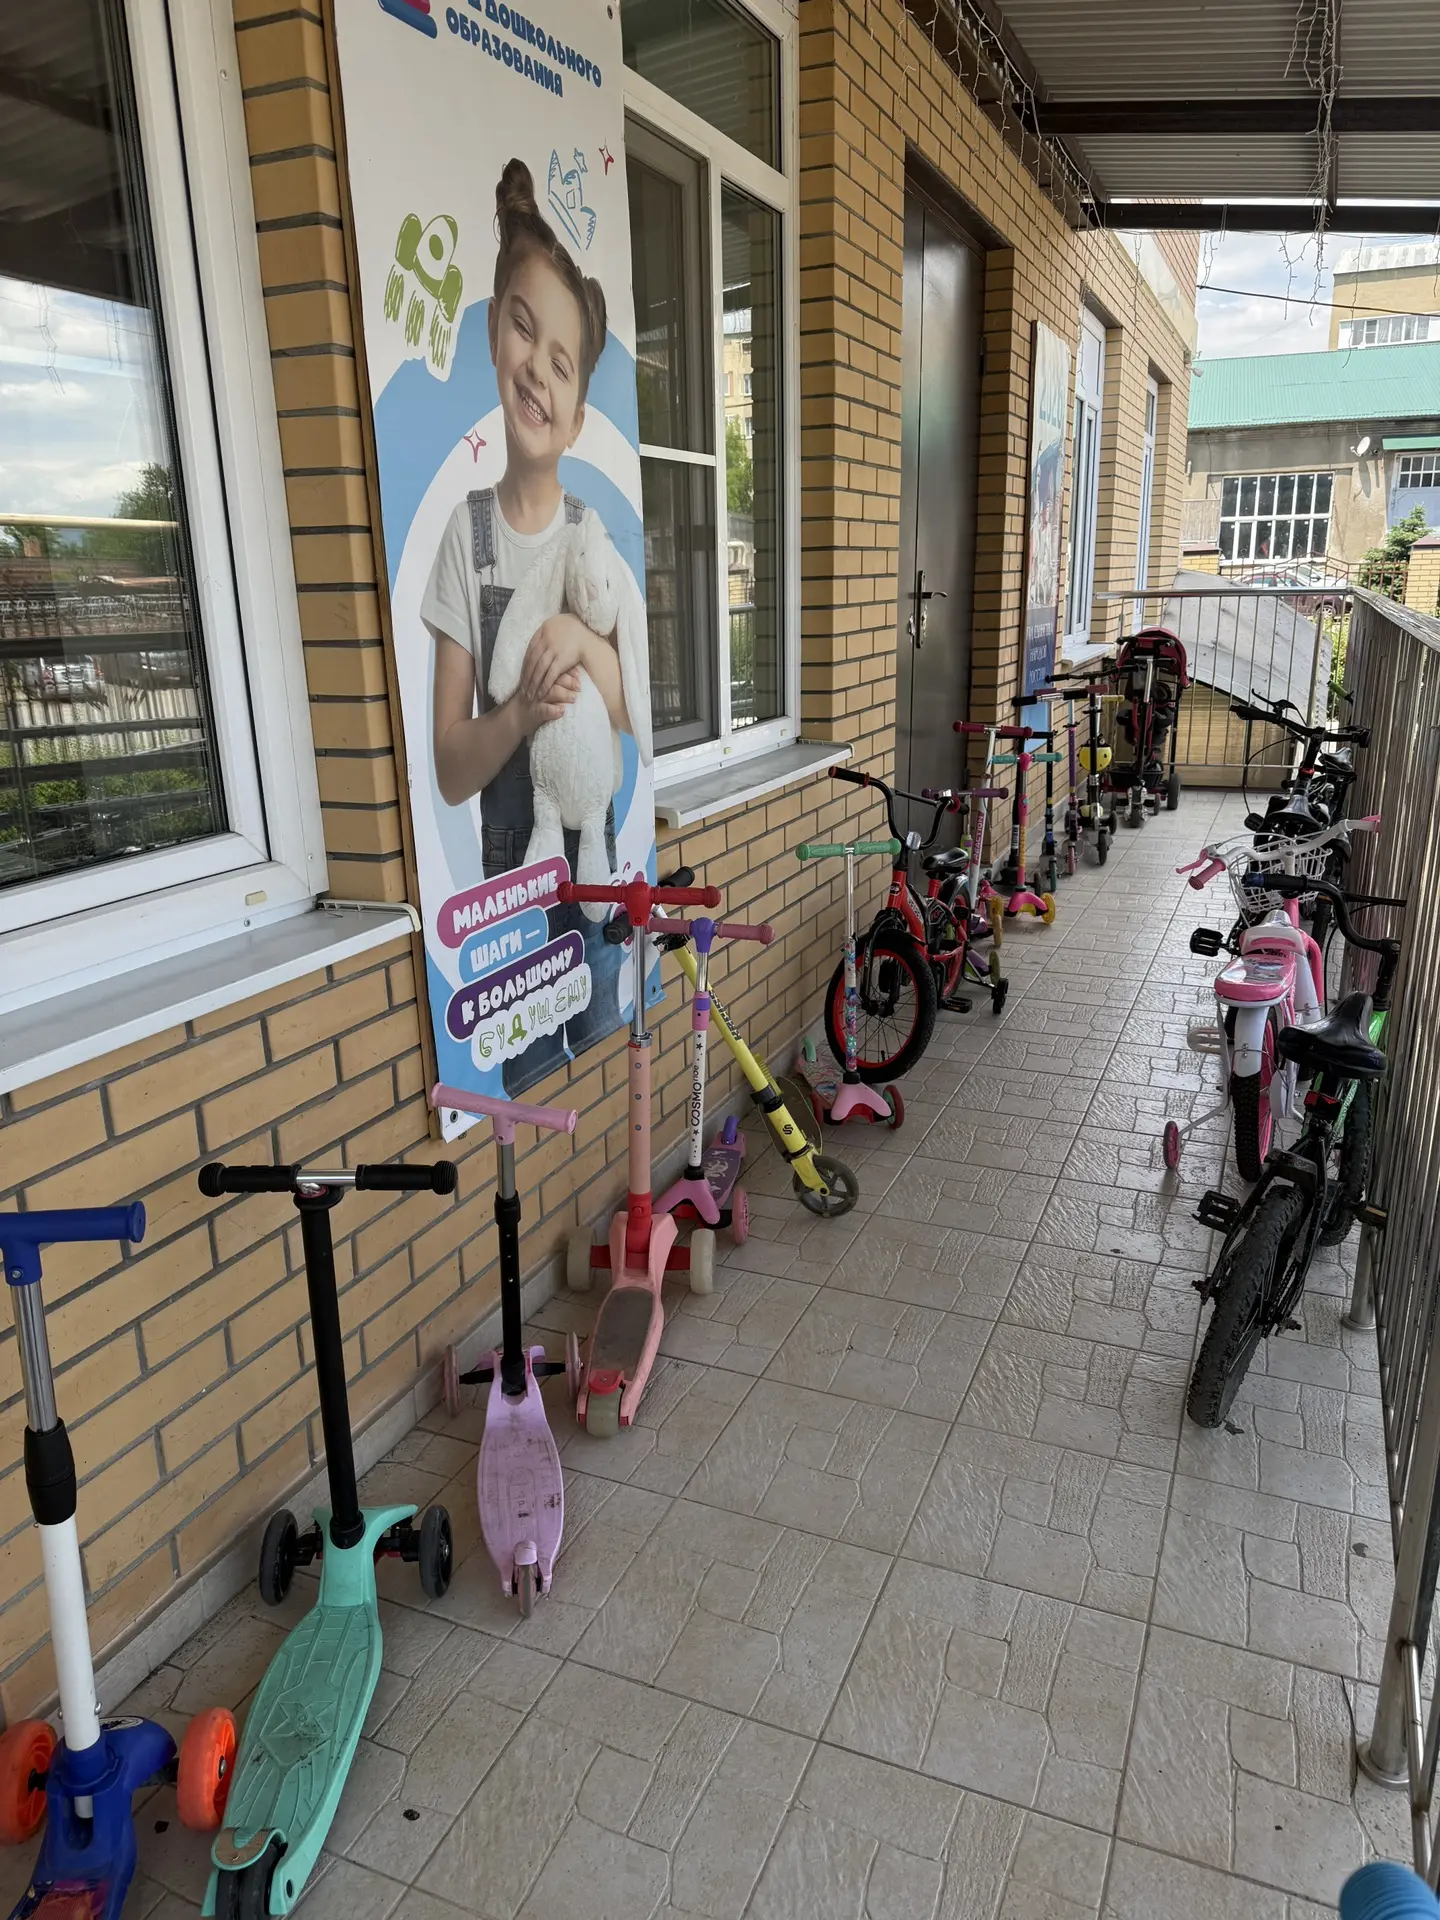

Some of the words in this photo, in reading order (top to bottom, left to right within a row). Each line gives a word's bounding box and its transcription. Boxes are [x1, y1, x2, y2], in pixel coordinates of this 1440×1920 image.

[445, 7, 563, 98] ОБРАЗОВАНИЯ
[485, 0, 602, 88] ДОШКОЛЬНОГО
[973, 815, 984, 861] REACTION
[452, 869, 558, 934] МАЛЕНЬКИЕ
[461, 999, 476, 1026] К
[478, 945, 574, 1017] БОЛЬШОМУ
[470, 928, 523, 973] ШАГИ
[478, 974, 587, 1058] БУДУЩЕМУ
[690, 1082, 702, 1127] COSMO
